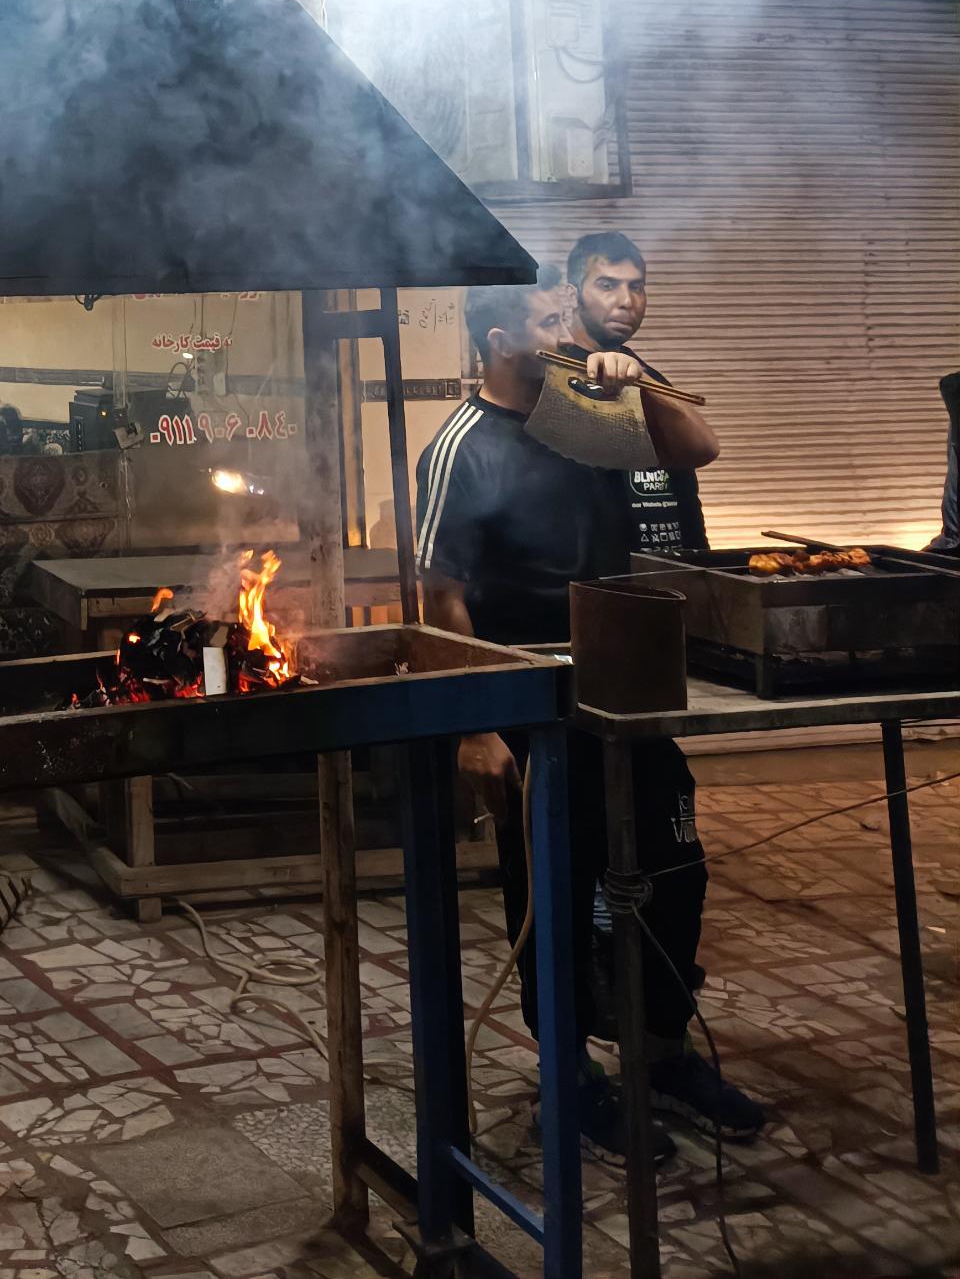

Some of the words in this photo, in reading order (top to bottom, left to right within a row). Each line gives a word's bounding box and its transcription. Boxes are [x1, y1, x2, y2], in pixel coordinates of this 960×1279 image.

[151, 334, 191, 353] کارخانه
[192, 332, 222, 354] قیمت
[150, 414, 196, 447] ۰۹۱۱
